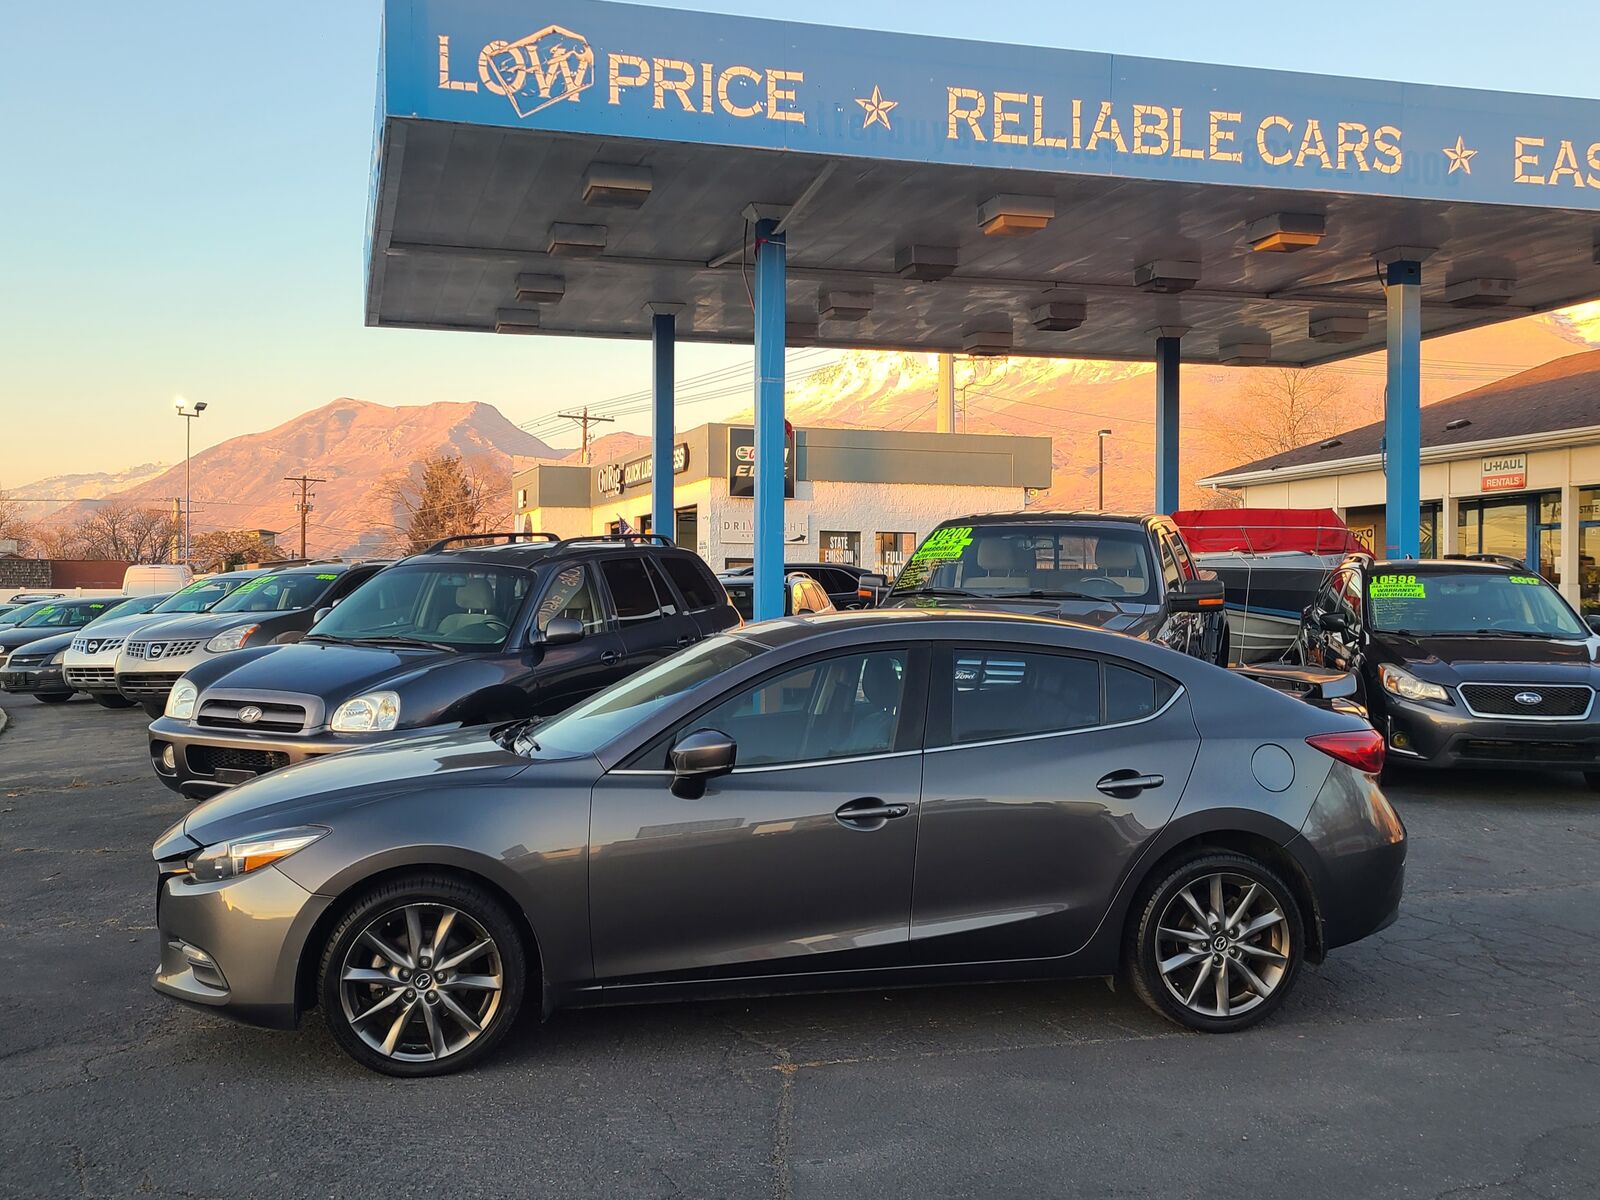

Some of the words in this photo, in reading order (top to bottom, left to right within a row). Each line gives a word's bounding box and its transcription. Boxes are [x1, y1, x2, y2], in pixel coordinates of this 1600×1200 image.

[438, 35, 594, 102] LOW
[608, 53, 804, 124] PRICE
[946, 85, 1243, 165] RELIABLE
[1256, 115, 1402, 175] CARS
[1483, 458, 1524, 472] U-HAUL
[1486, 476, 1520, 488] RENTALS
[829, 536, 849, 550] STATE
[885, 550, 904, 564] FULL
[1371, 575, 1417, 584] 10598
